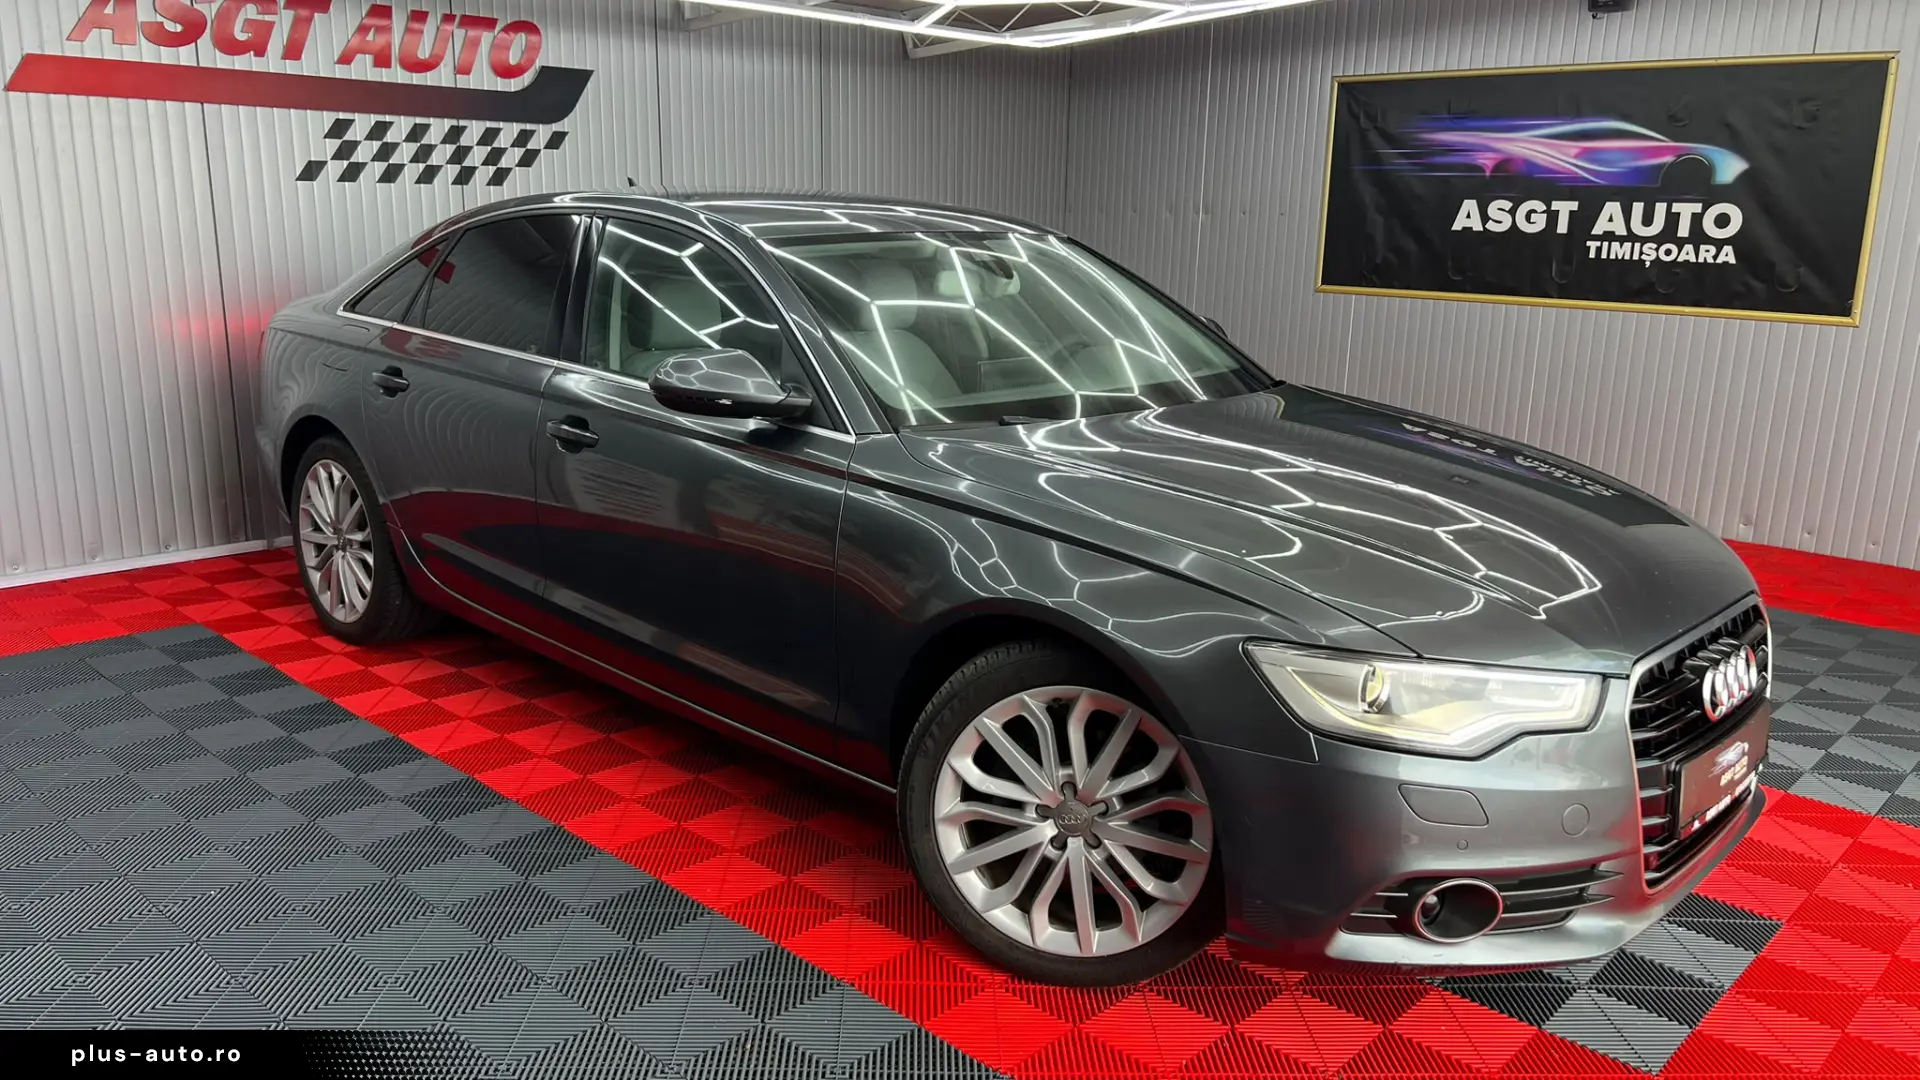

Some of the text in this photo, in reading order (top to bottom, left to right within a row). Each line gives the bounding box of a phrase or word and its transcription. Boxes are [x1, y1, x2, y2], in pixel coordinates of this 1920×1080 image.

[65, 0, 542, 80] ASGT AUTO
[1451, 199, 1743, 239] ASGT AUTO
[1585, 240, 1737, 267] TIMIȘOARA
